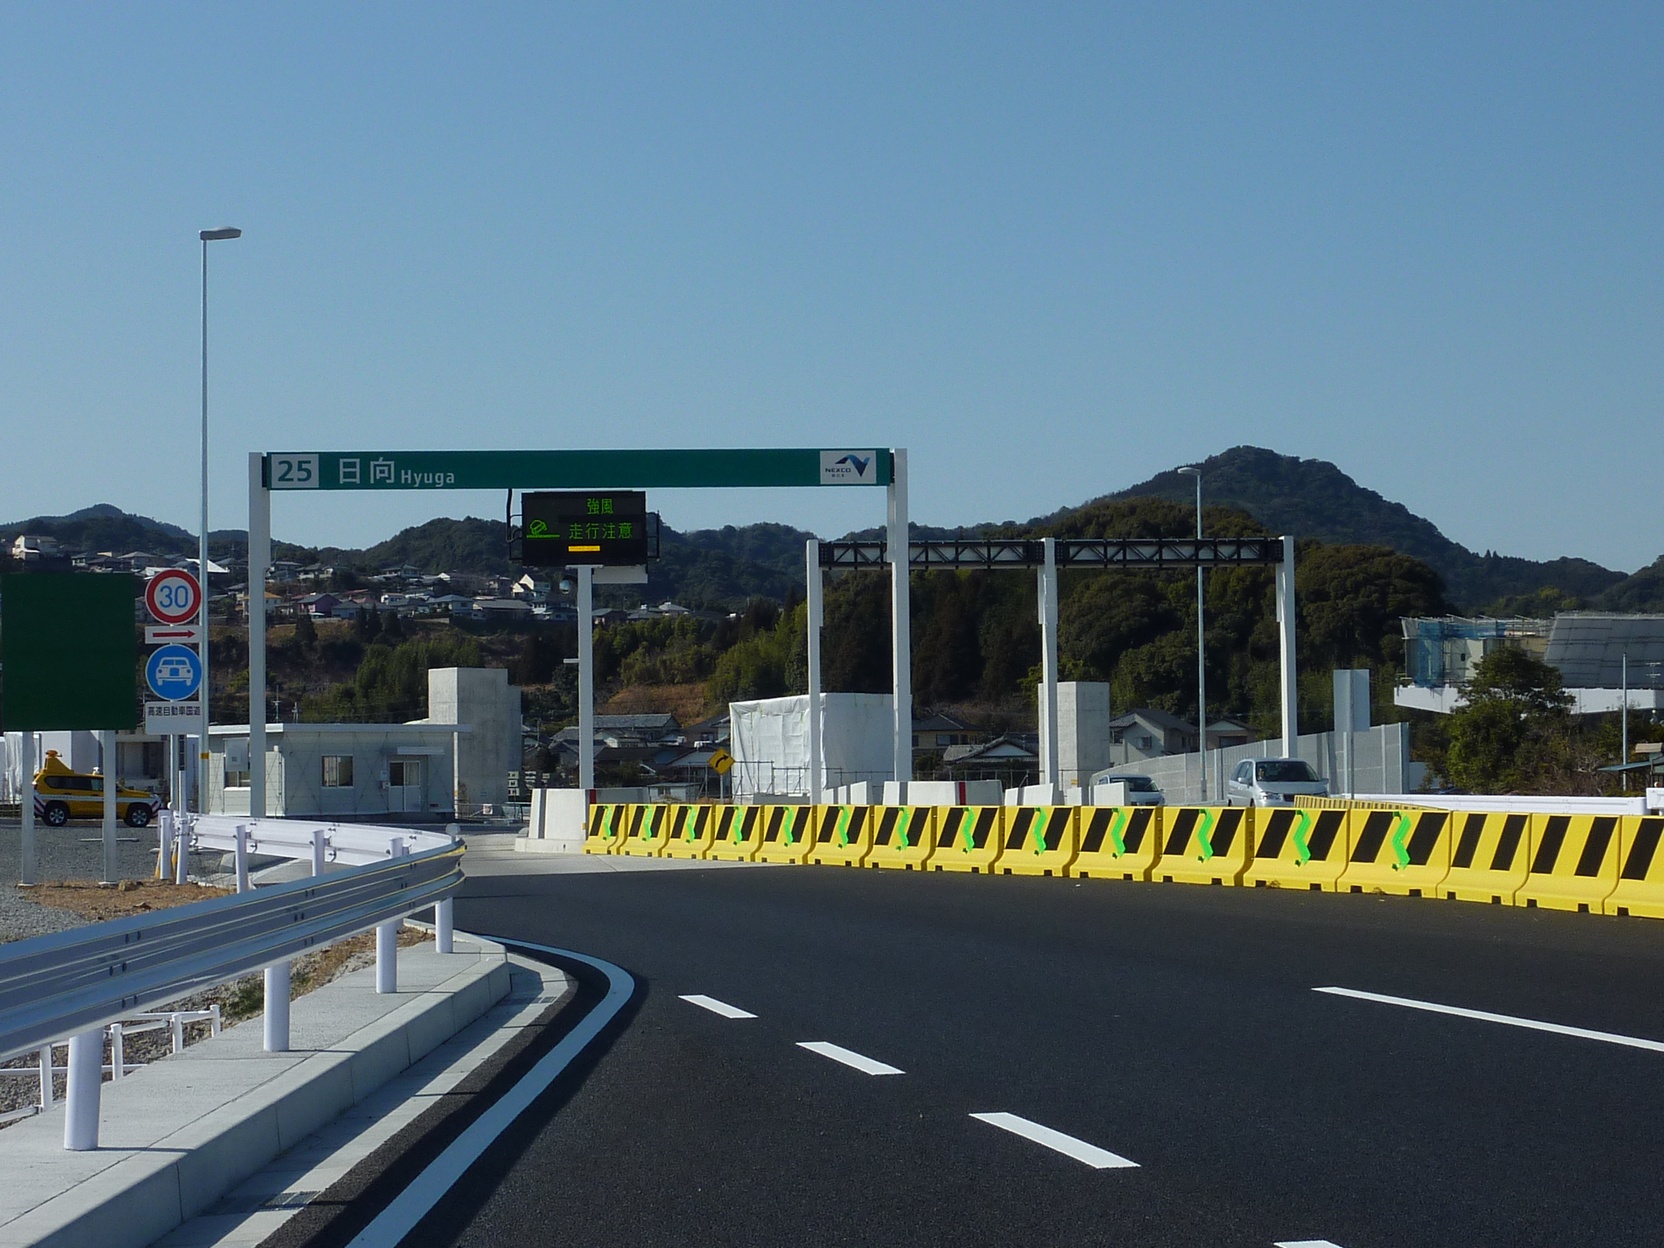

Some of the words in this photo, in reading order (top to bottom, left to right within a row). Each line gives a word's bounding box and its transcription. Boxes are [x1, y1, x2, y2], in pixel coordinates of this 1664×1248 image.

[277, 460, 313, 482] 25
[339, 457, 395, 484] 日向
[401, 469, 455, 487] Hyuga
[586, 498, 614, 515] 強風
[568, 522, 633, 540] 走行注意
[159, 585, 189, 609] 30
